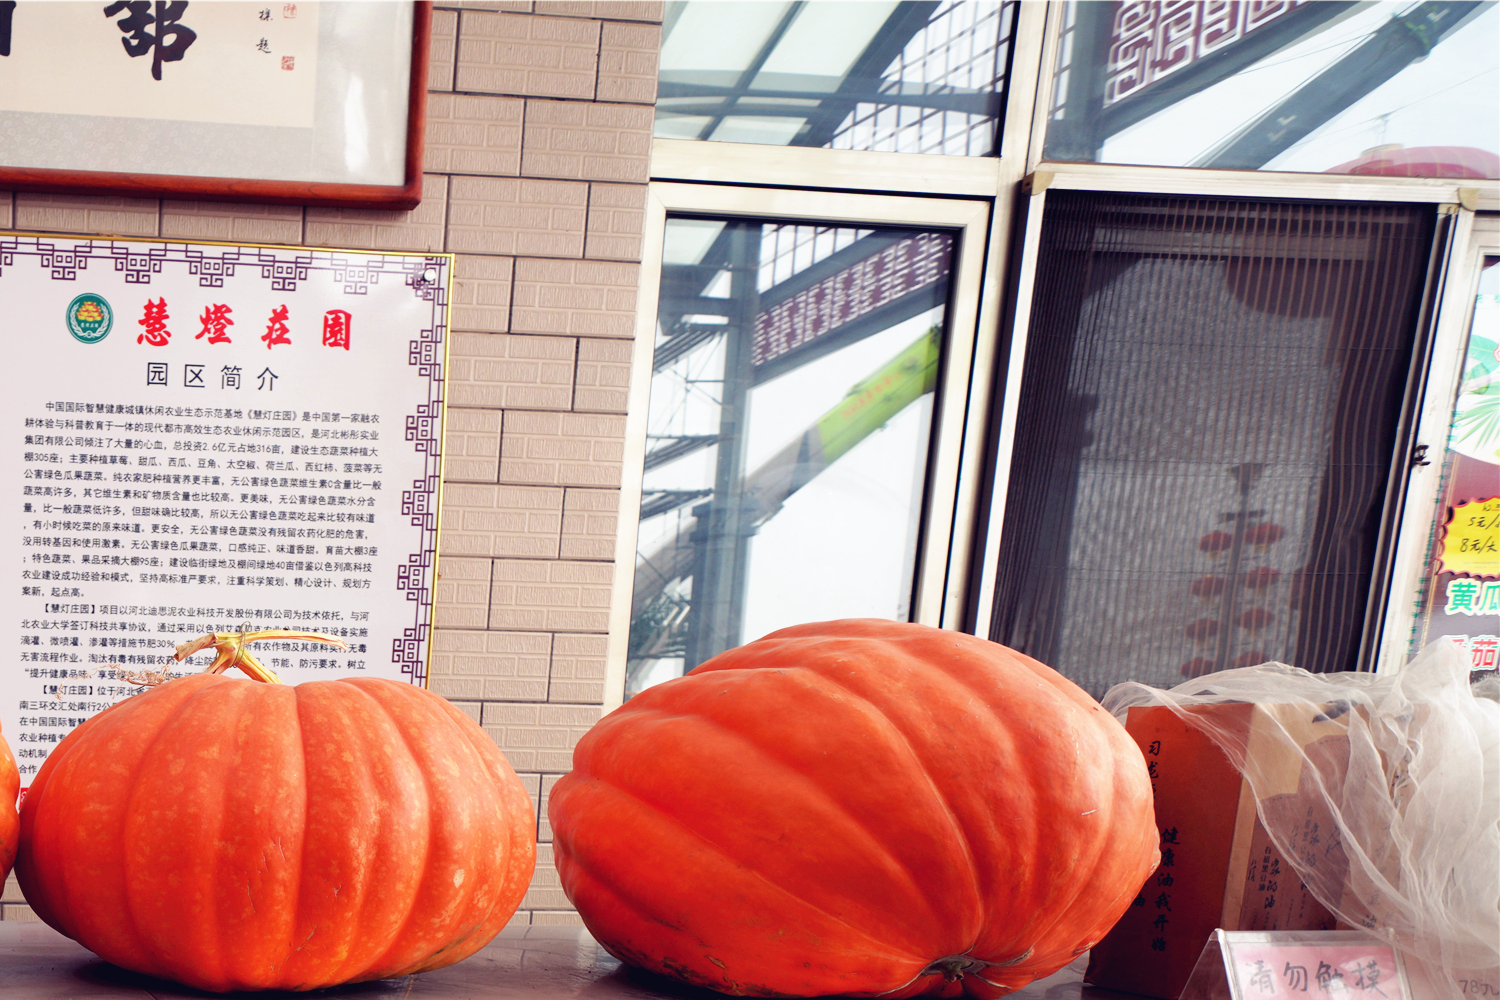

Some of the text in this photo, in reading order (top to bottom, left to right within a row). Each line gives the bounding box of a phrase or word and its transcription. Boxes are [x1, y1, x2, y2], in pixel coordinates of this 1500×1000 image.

[146, 362, 280, 392] 园区简介
[21, 586, 85, 597] 案新，起点高。
[19, 700, 119, 712] 南三环交汇处南行2公
[18, 749, 48, 759] 动机制
[18, 764, 38, 774] 合作
